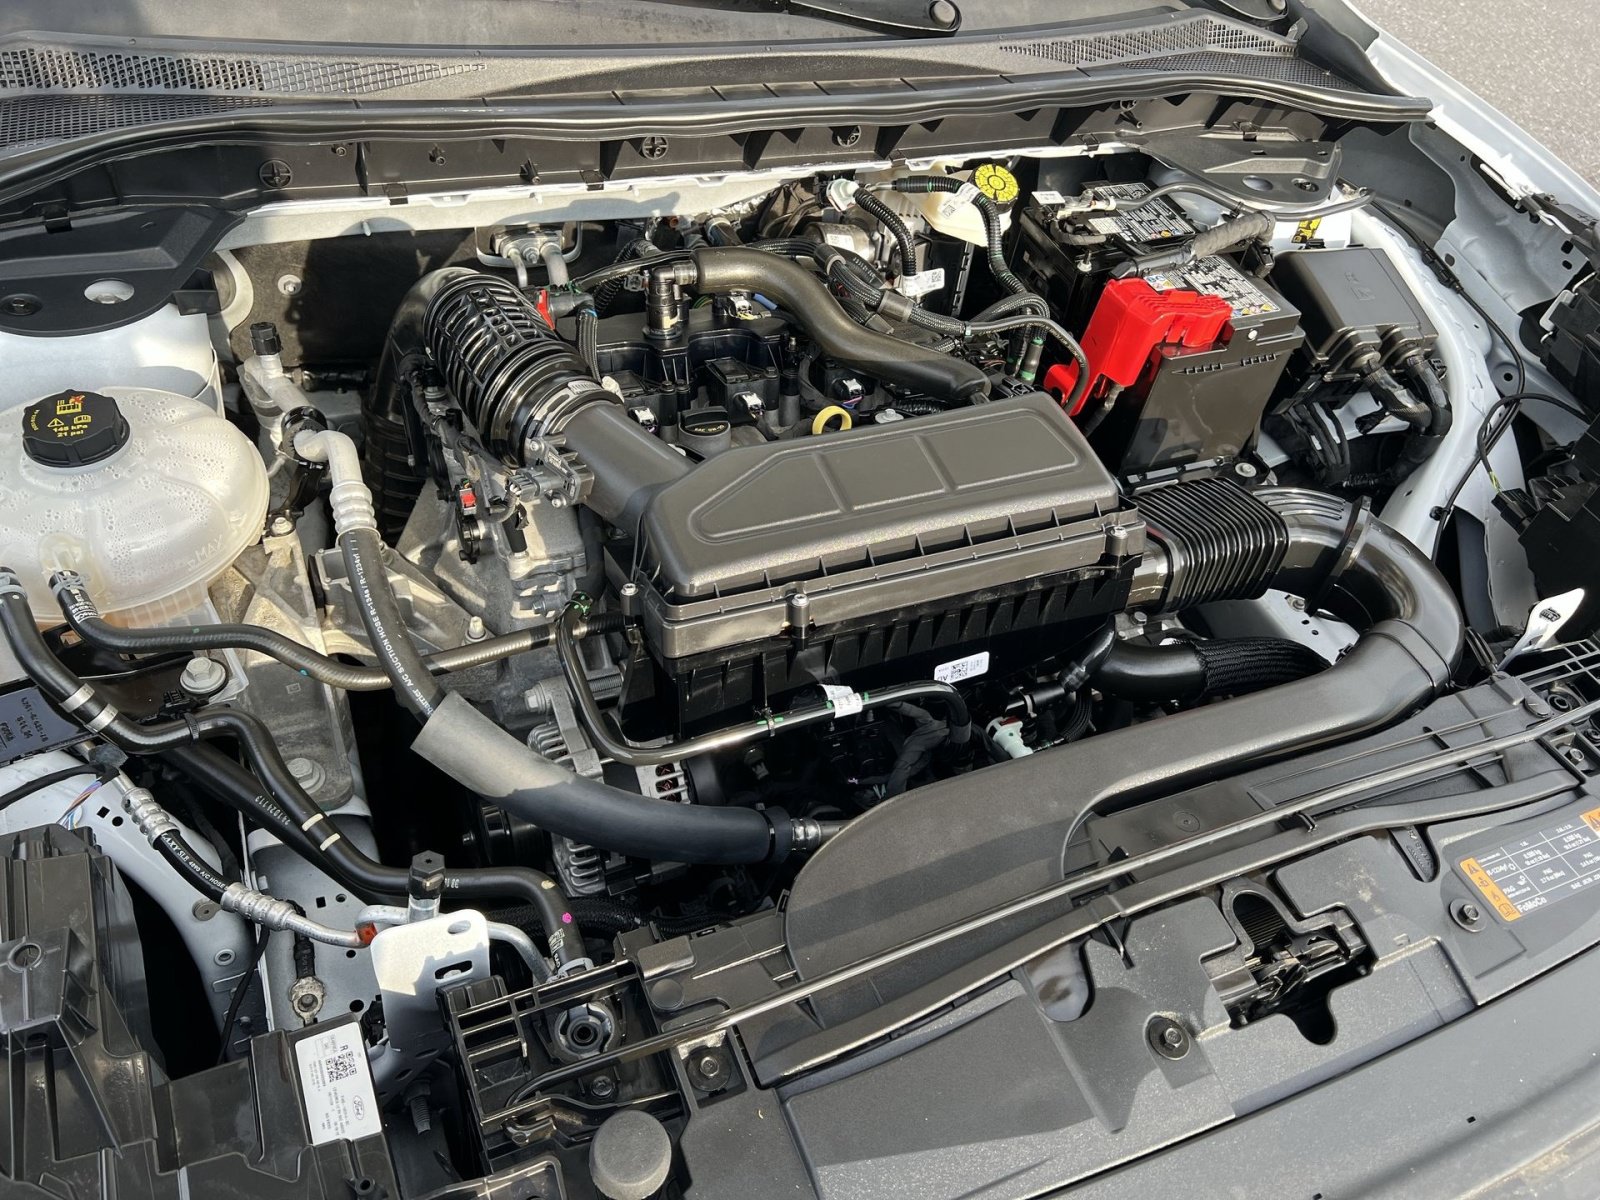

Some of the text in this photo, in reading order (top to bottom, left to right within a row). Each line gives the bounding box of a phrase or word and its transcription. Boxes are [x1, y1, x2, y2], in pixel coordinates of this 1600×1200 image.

[194, 534, 224, 562] MAX
[364, 589, 376, 616] R-134a
[372, 616, 386, 639] HOSE
[382, 638, 405, 674] SUCTION
[402, 673, 414, 687] A/C
[209, 876, 226, 889] HOSE
[1516, 897, 1547, 912] FoMoCo
